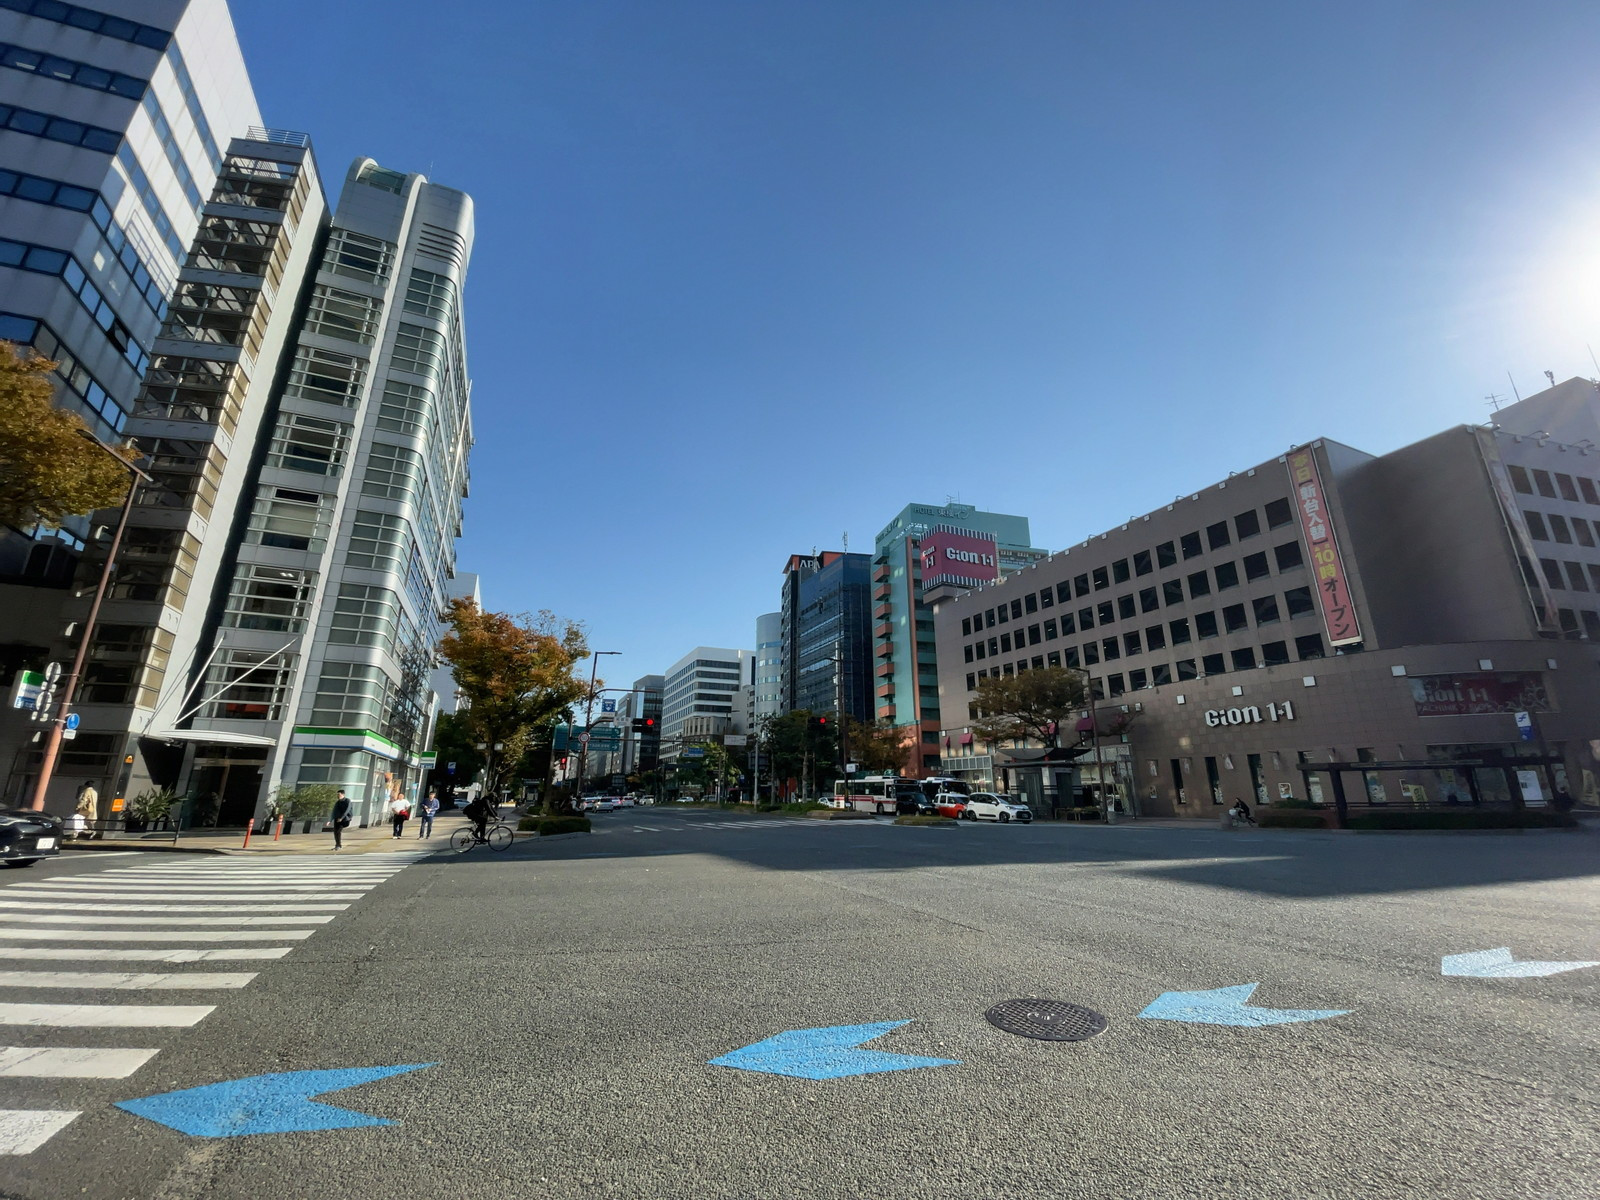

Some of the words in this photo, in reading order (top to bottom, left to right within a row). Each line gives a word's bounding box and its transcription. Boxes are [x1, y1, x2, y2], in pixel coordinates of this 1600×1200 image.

[914, 506, 935, 517] HOTEL
[946, 547, 980, 564] Gion
[1205, 705, 1263, 727] Gion
